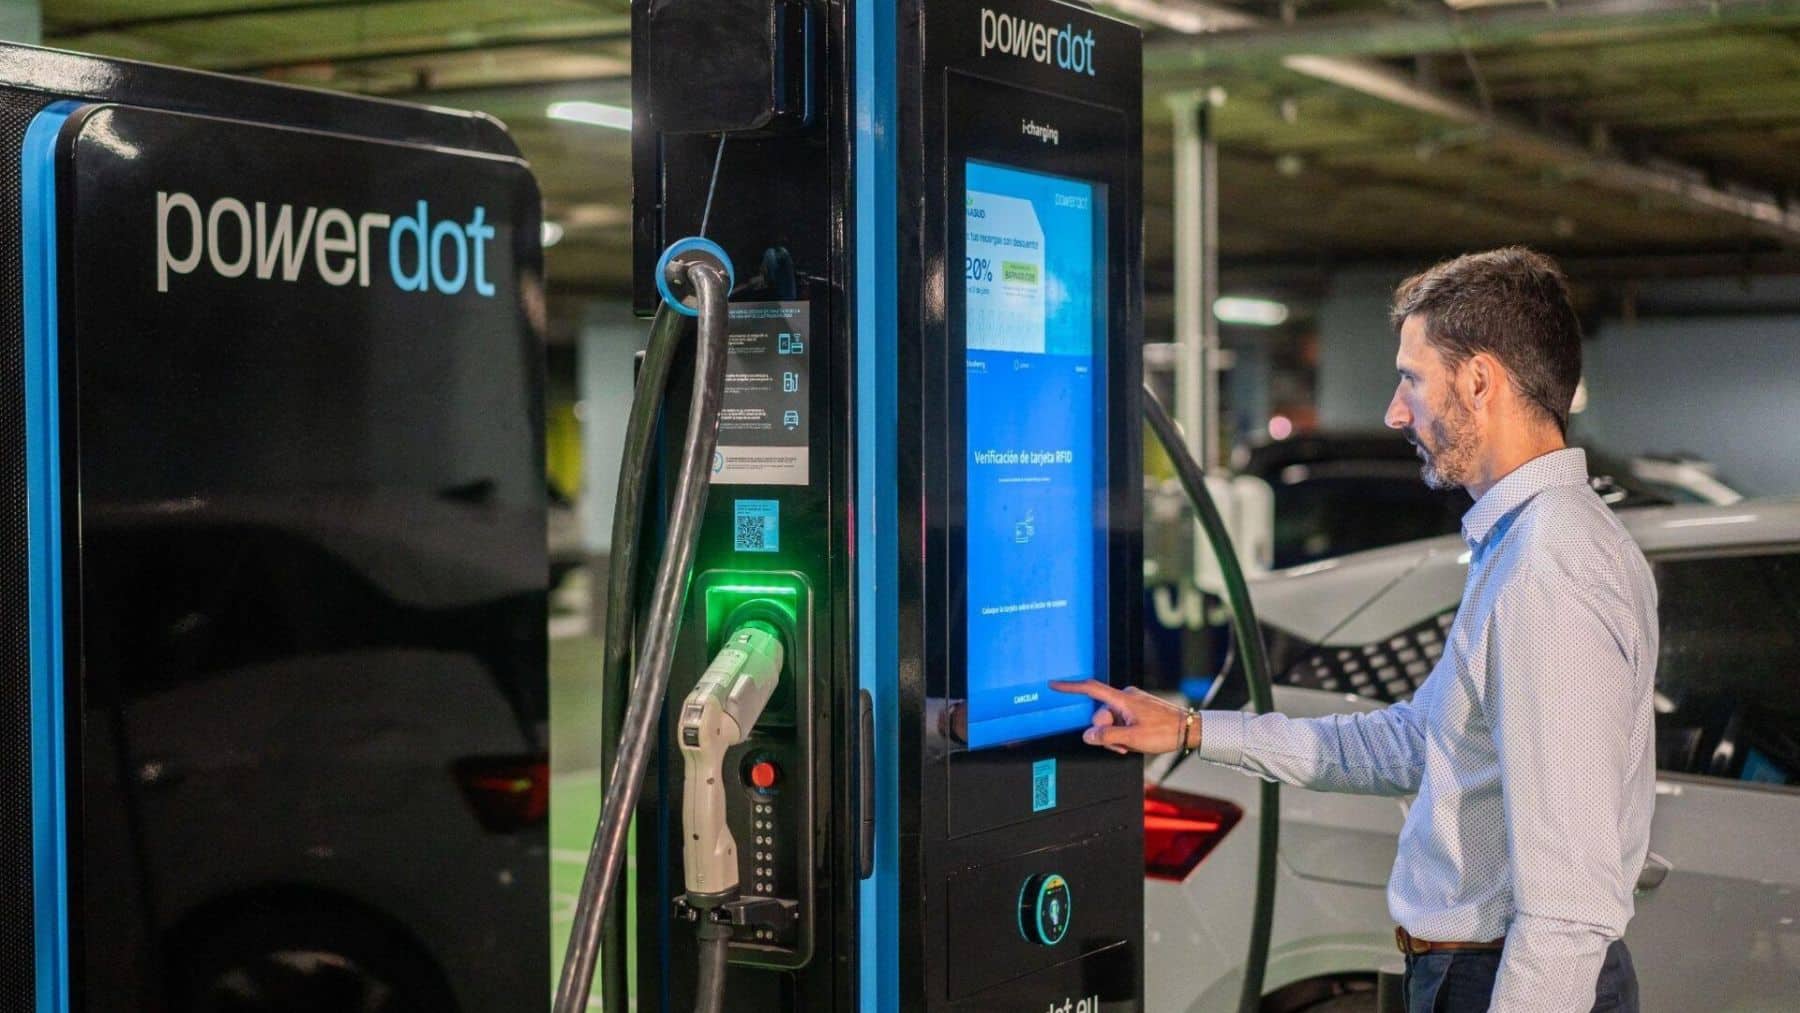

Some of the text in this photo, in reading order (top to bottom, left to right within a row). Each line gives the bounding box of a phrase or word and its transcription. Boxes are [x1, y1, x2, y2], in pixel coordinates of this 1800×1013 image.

[981, 8, 1095, 76] powerdot
[1022, 119, 1058, 145] i-charging
[157, 191, 495, 297] powerdot
[974, 449, 1073, 467] Verificación de tarjeta RFID
